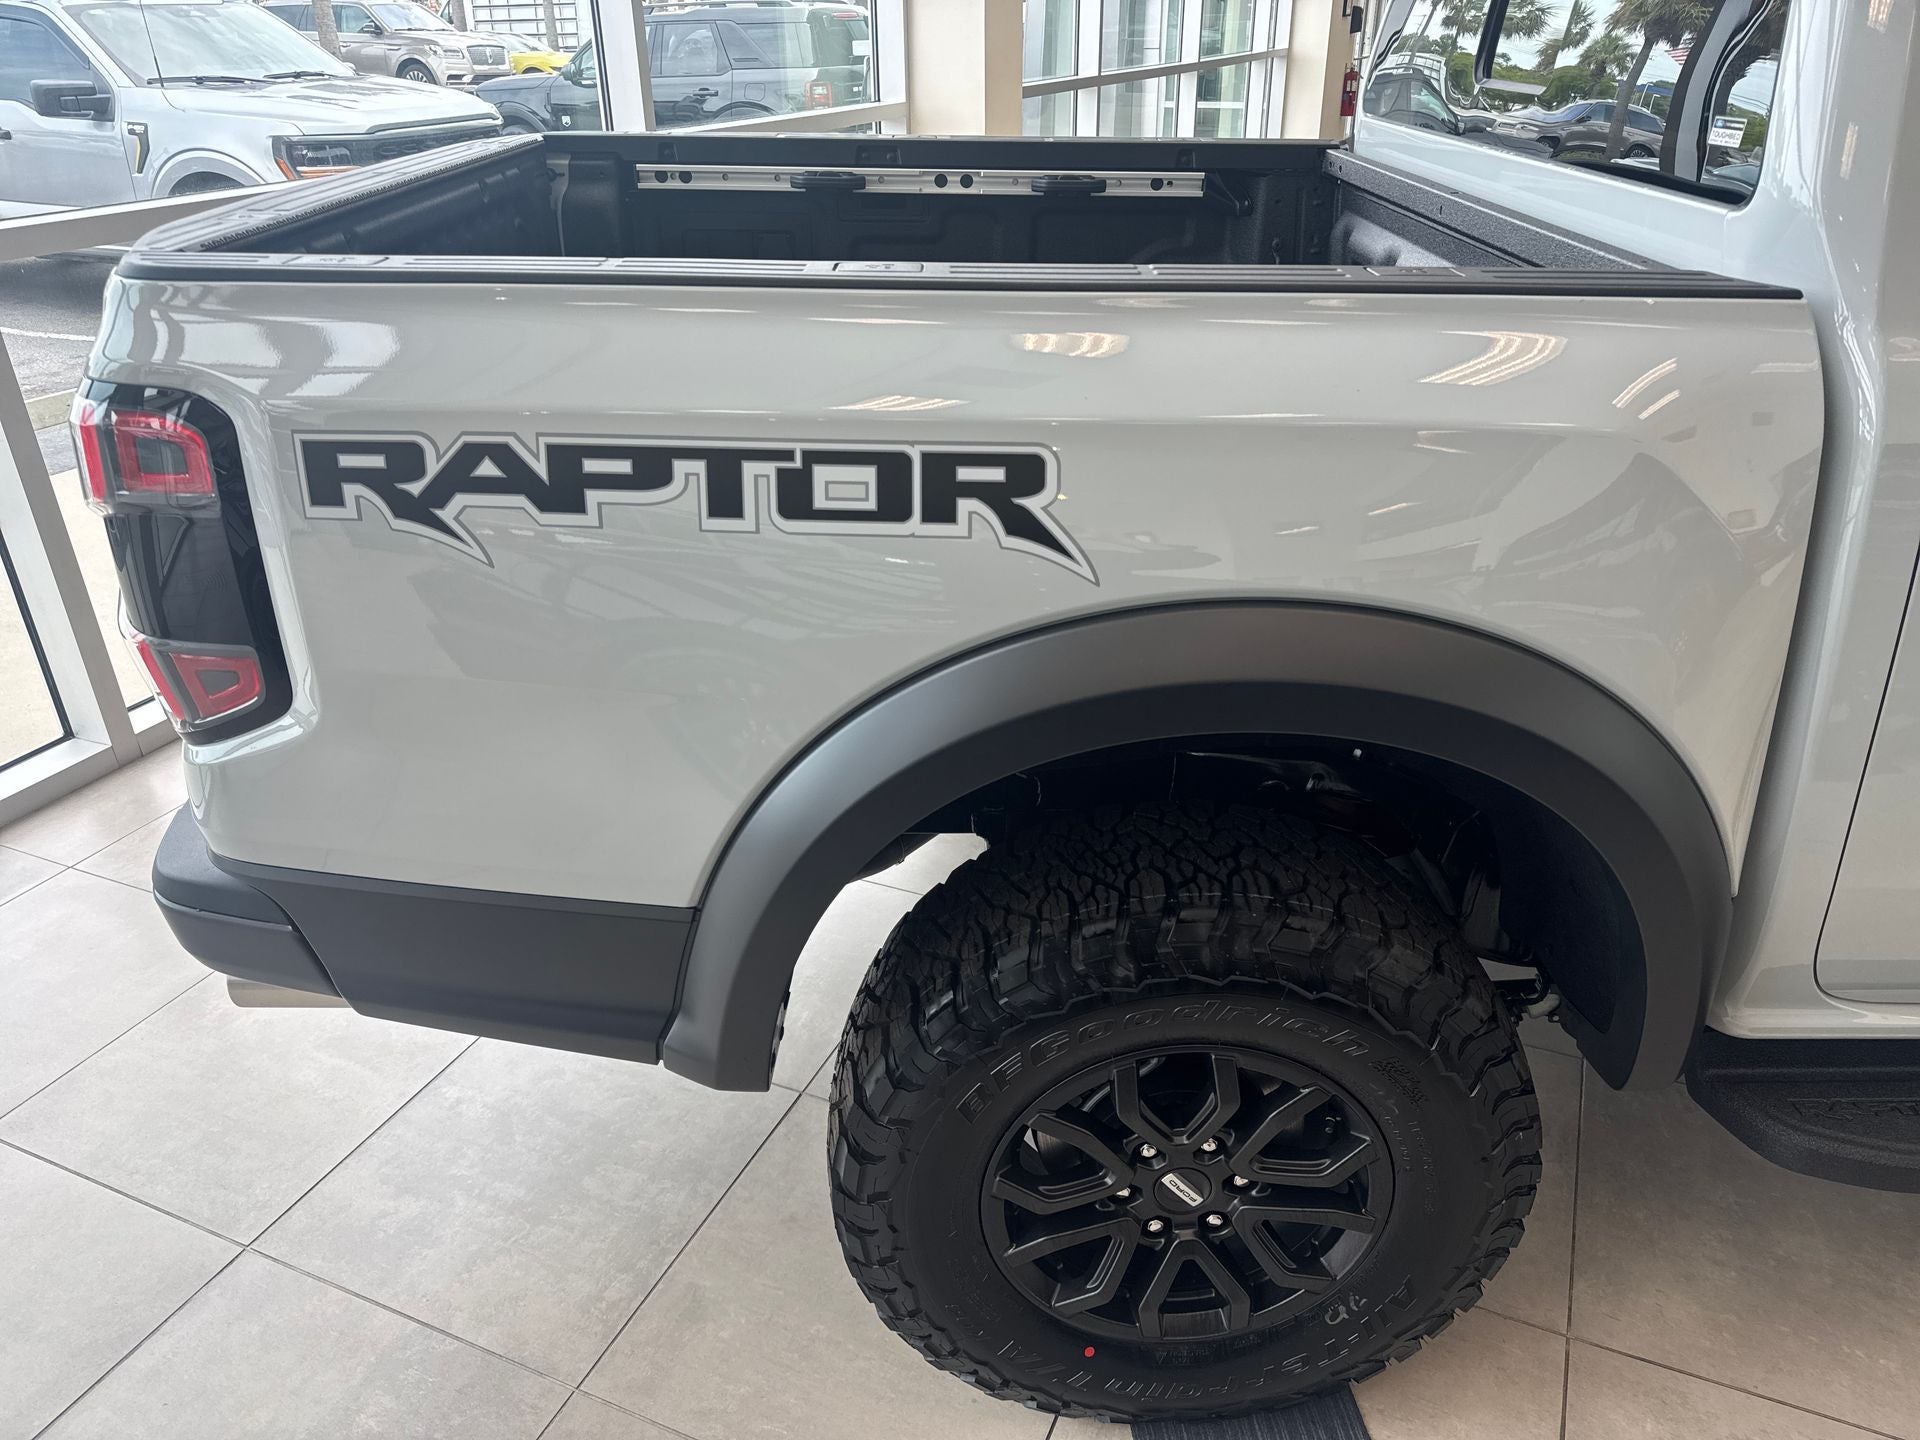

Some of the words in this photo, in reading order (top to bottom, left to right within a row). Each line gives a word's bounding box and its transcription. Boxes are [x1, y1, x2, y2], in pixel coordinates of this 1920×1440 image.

[292, 430, 1101, 587] RAPTOR
[955, 999, 1370, 1126] BFGoodrich
[1168, 1178, 1199, 1203] FORD
